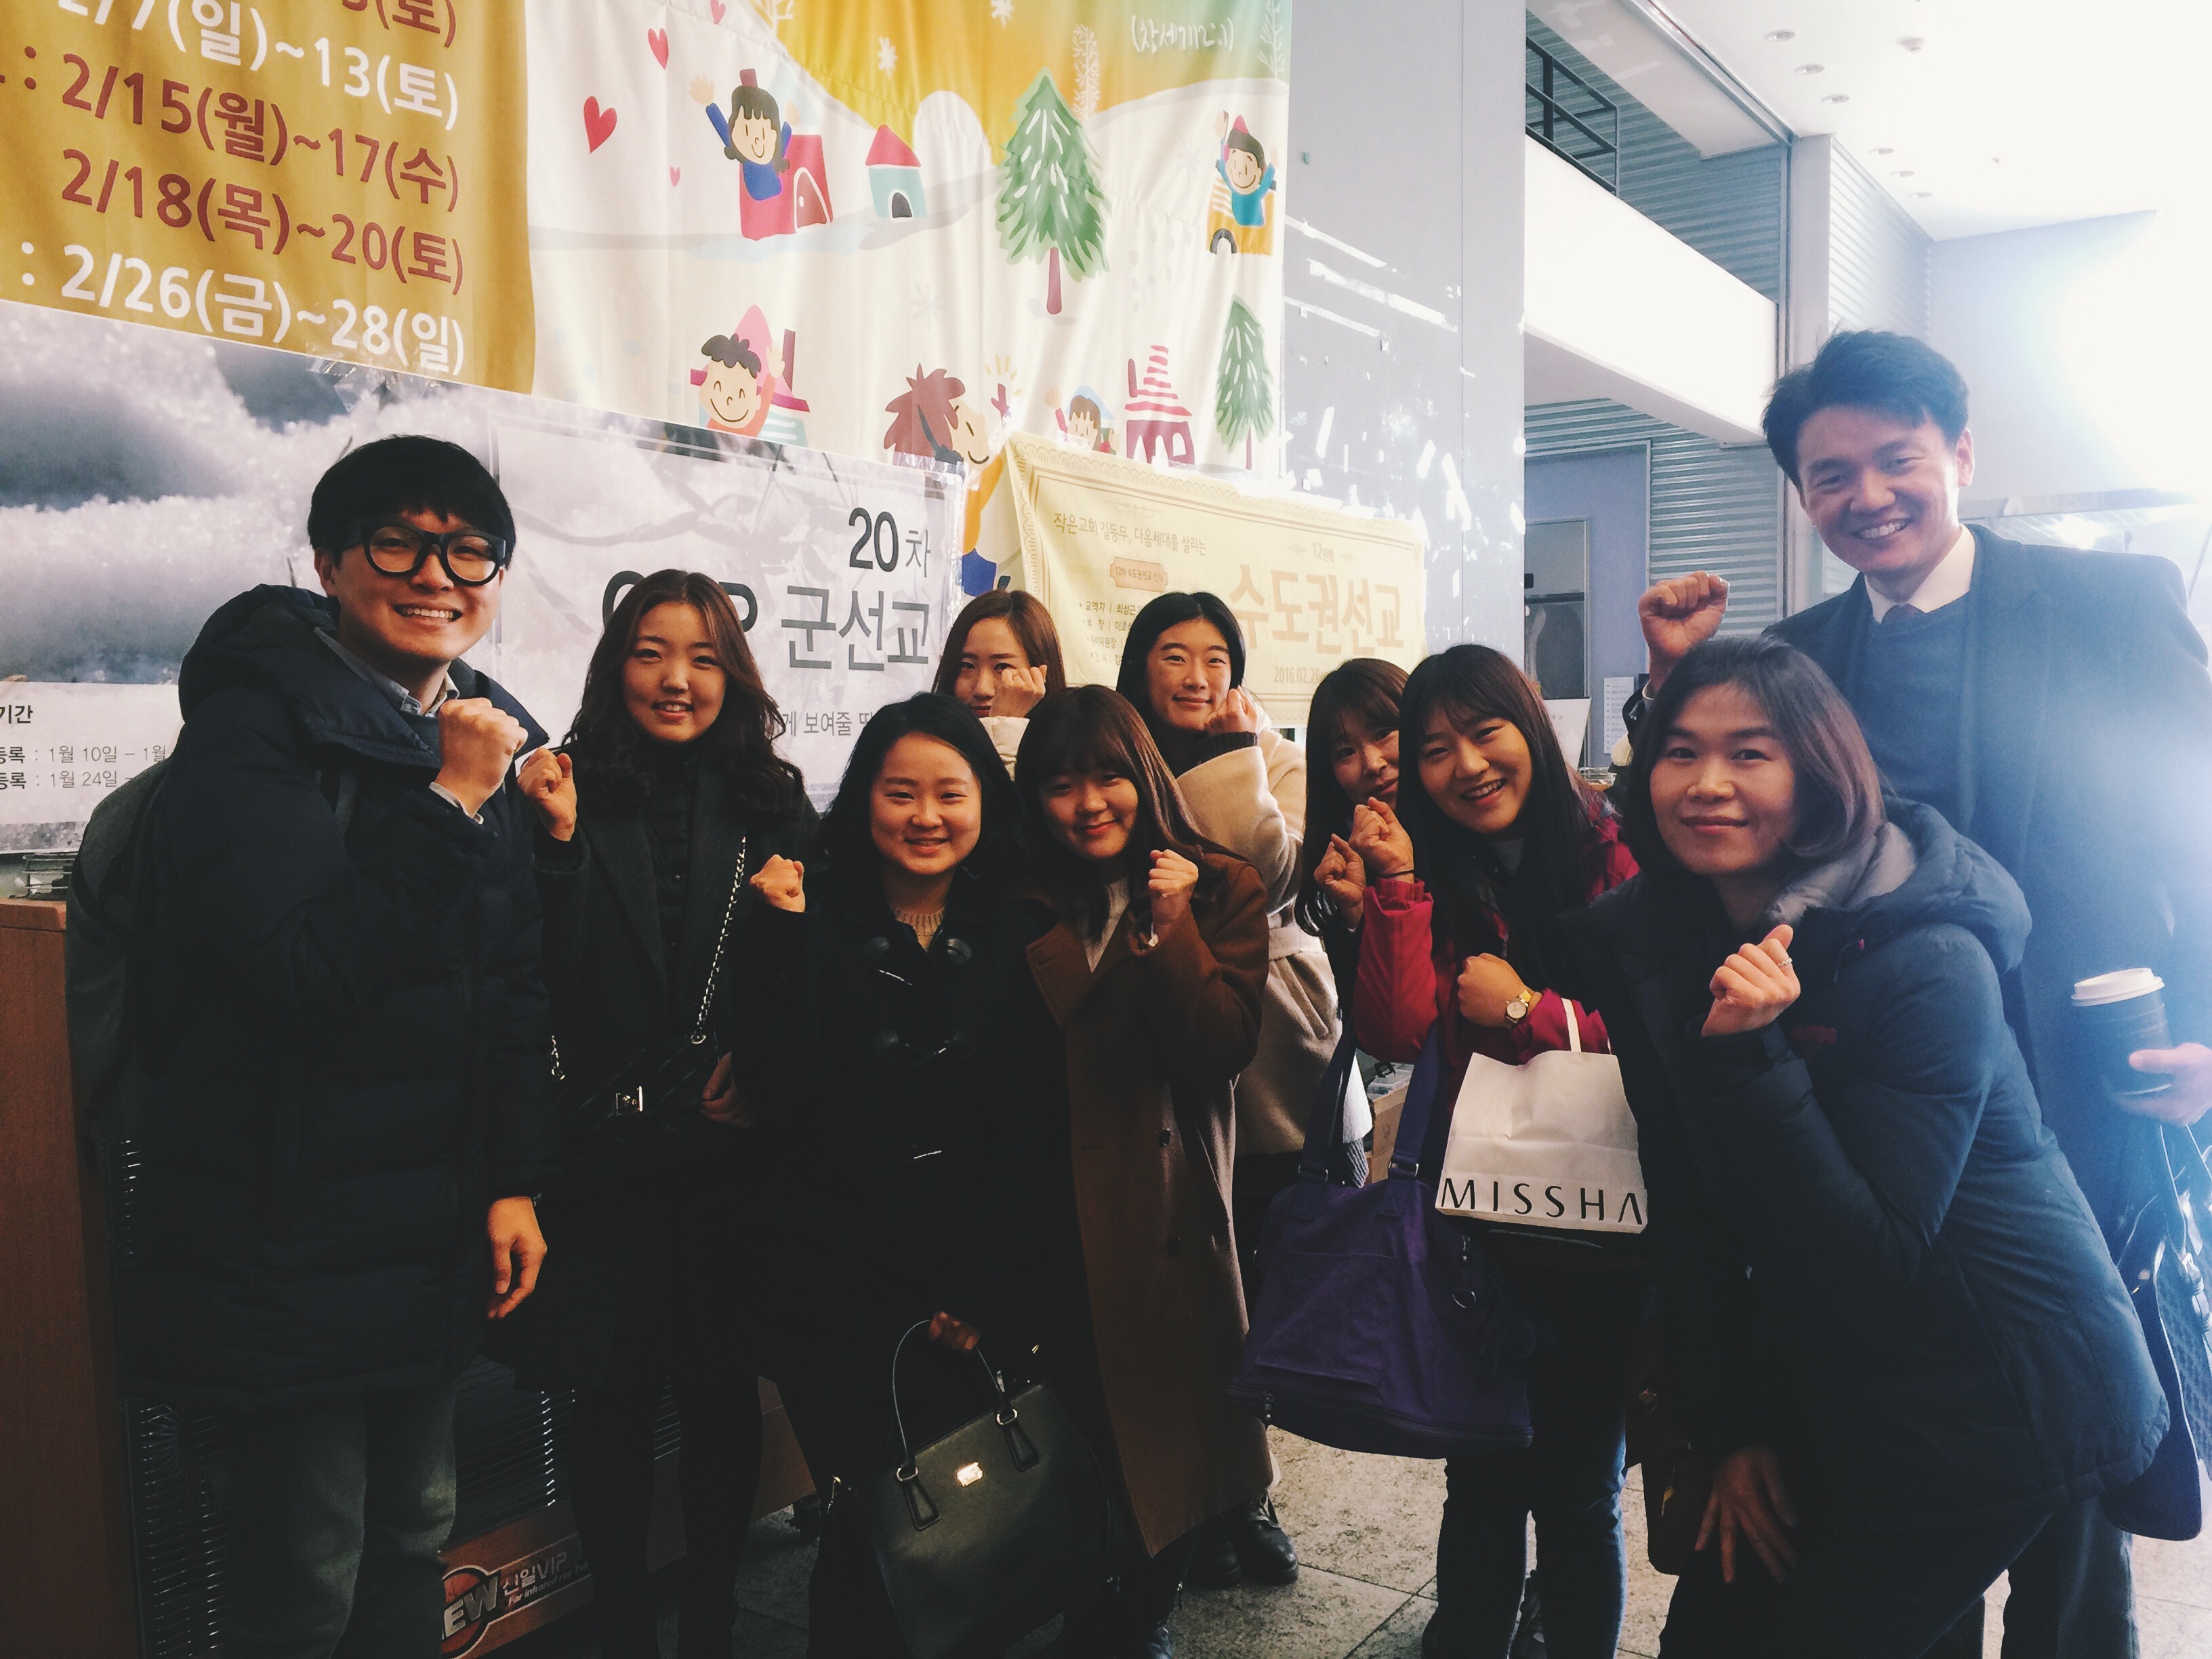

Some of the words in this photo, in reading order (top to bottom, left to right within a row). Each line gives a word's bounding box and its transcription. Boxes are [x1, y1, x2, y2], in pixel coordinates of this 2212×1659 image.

[342, 0, 456, 48] (토)
[62, 54, 458, 212] 2/15(월)~17(수)
[62, 148, 463, 295] 2/18(목)~20(토)
[61, 244, 464, 375] 2/26(금)~28(일)
[1053, 512, 1098, 535] 작은교회
[1100, 521, 1131, 544] 길동무,
[1134, 527, 1179, 551] 다음세대를
[1181, 536, 1207, 556] 살리는
[781, 586, 930, 671] 군선교
[1086, 601, 1106, 613] 교역자
[1117, 603, 1136, 615] 최성근
[1229, 563, 1404, 656] 수도권선교
[804, 711, 853, 737] 보여줄
[49, 745, 74, 764] 1월
[83, 746, 117, 763] 10일
[50, 771, 75, 788] 1월
[81, 771, 117, 787] 24일
[1441, 1178, 1643, 1225] MISSHA
[442, 1576, 498, 1641] EW
